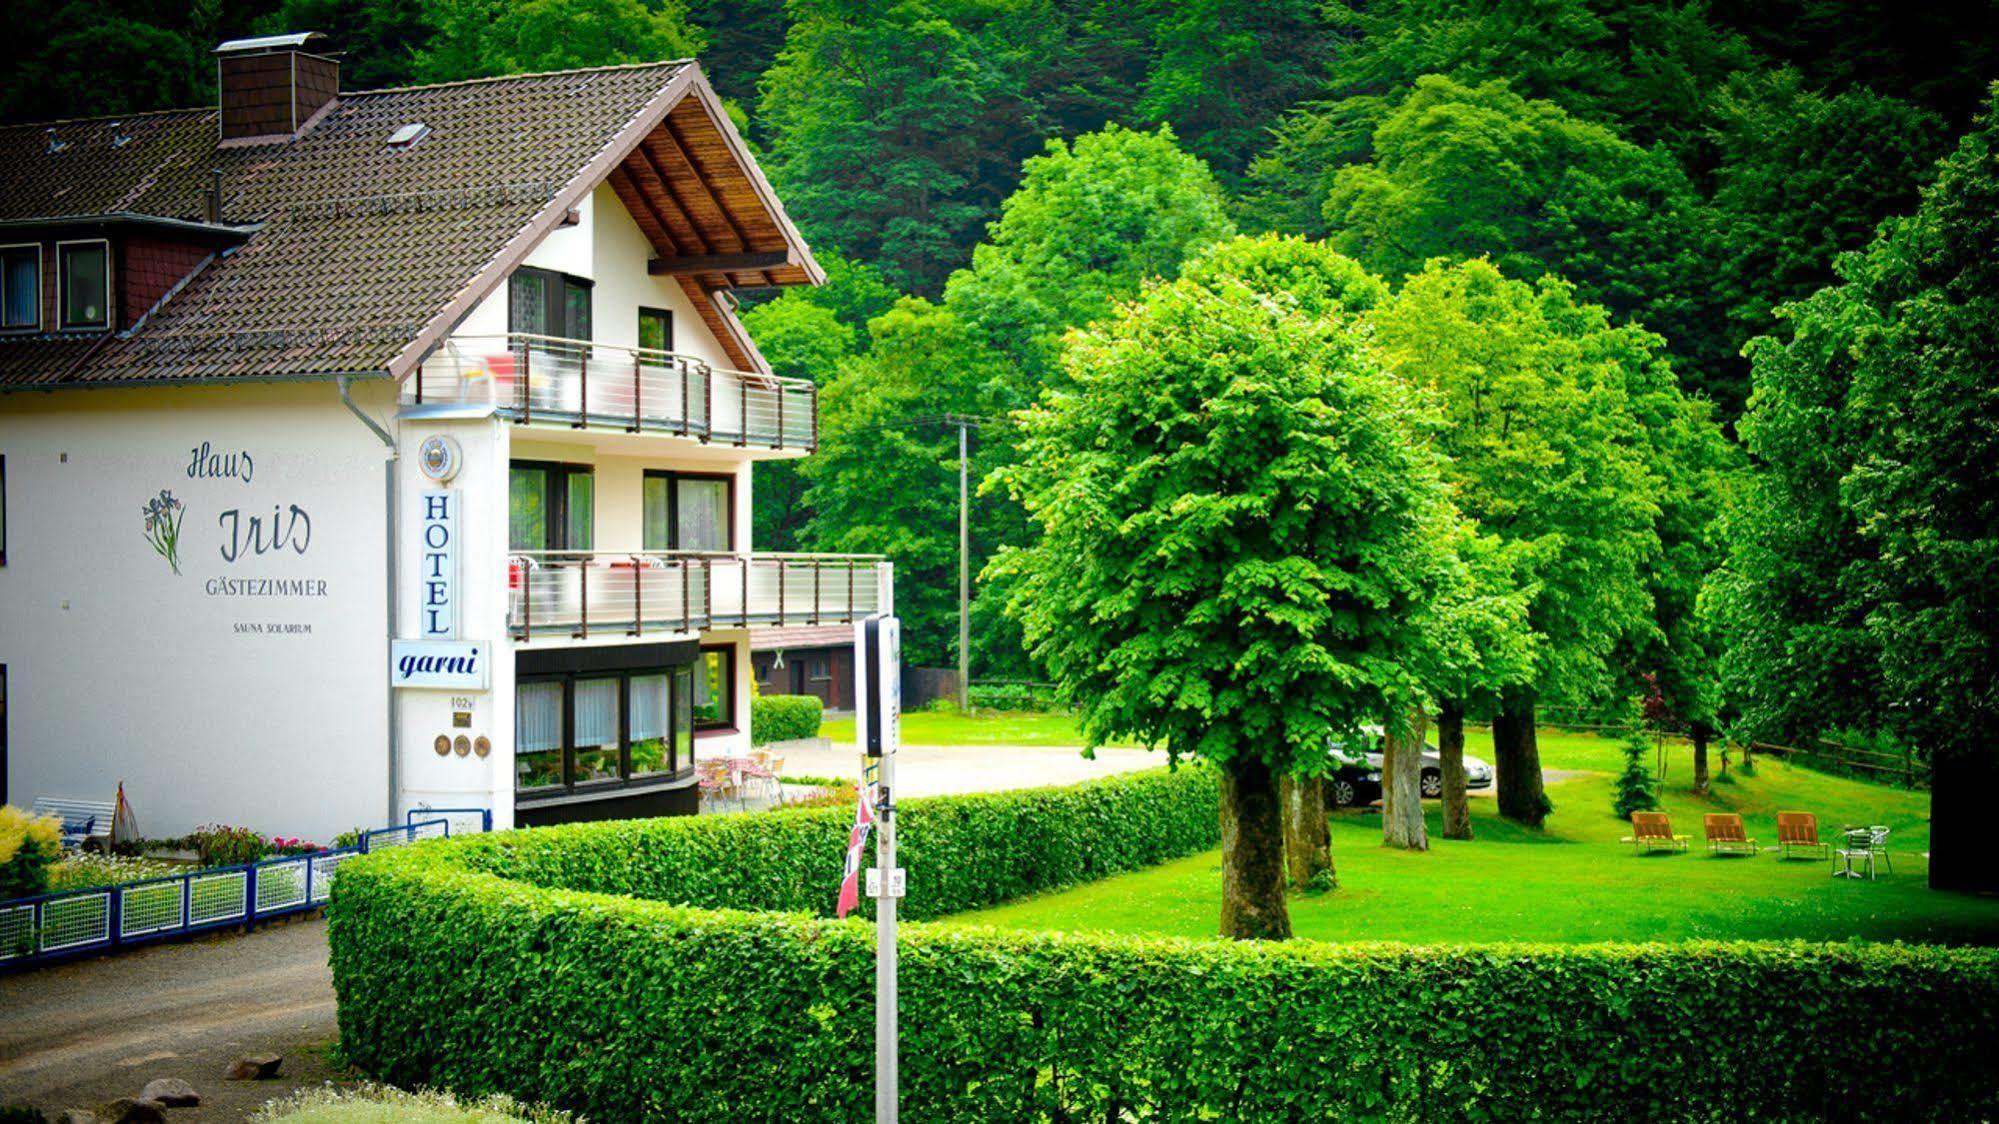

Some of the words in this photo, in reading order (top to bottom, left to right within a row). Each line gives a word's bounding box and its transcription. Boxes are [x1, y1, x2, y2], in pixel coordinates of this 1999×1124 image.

[187, 441, 253, 482] Haus
[219, 504, 311, 562] Iris
[425, 495, 449, 634] HOTEL
[206, 577, 328, 597] GÄSTEZIMMER
[233, 623, 263, 634] SAUNA
[266, 623, 312, 634] SOLARIUM
[399, 648, 479, 679] garni
